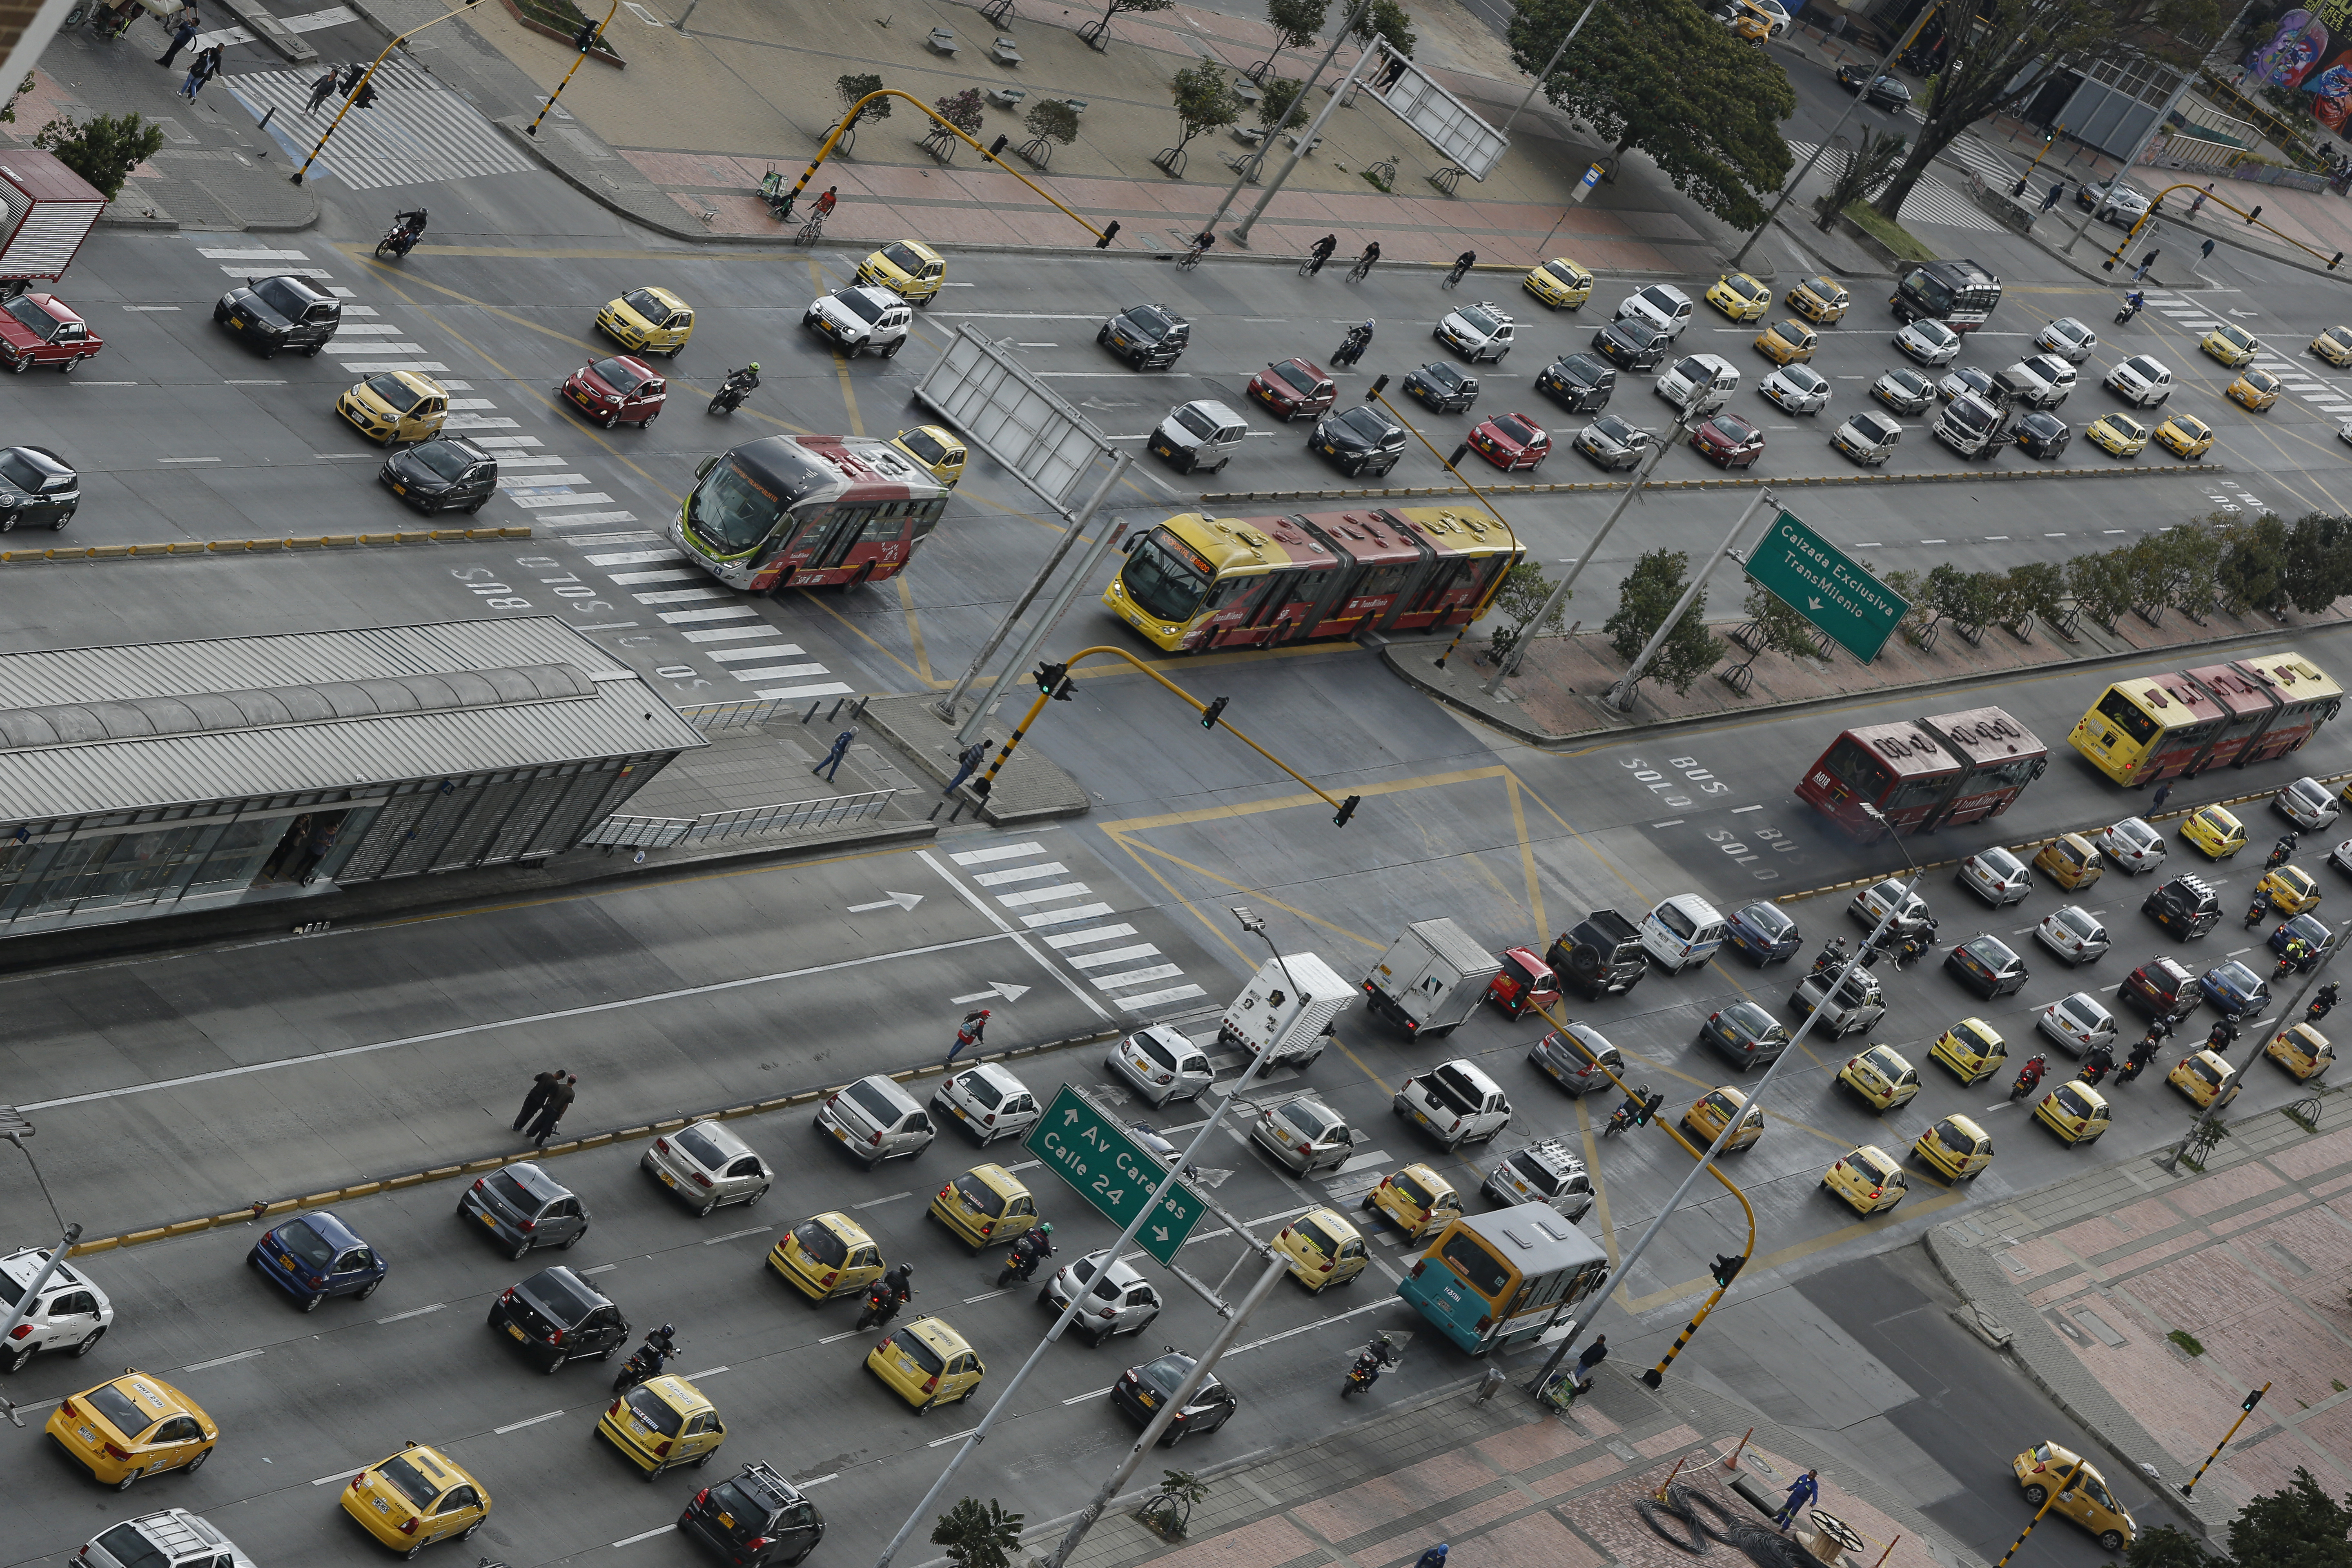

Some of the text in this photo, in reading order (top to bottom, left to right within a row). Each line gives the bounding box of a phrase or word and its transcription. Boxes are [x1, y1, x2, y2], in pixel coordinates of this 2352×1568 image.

[1189, 554, 1210, 573] DORADO
[1781, 524, 1894, 617] Calzada Exclusiva
[450, 567, 534, 610] BUS
[515, 556, 614, 613] SOLO
[1784, 550, 1863, 619] TransMilenio
[1212, 611, 1243, 622] TransMilenio
[2089, 718, 2106, 733] N106
[443, 783, 451, 793] A
[1619, 757, 1693, 807] SOLO
[1669, 756, 1728, 794] BUS
[1814, 771, 1831, 786] A018
[1706, 829, 1779, 880] SOLO
[1080, 1126, 1110, 1153] Av
[1044, 1131, 1125, 1206] Calle 24
